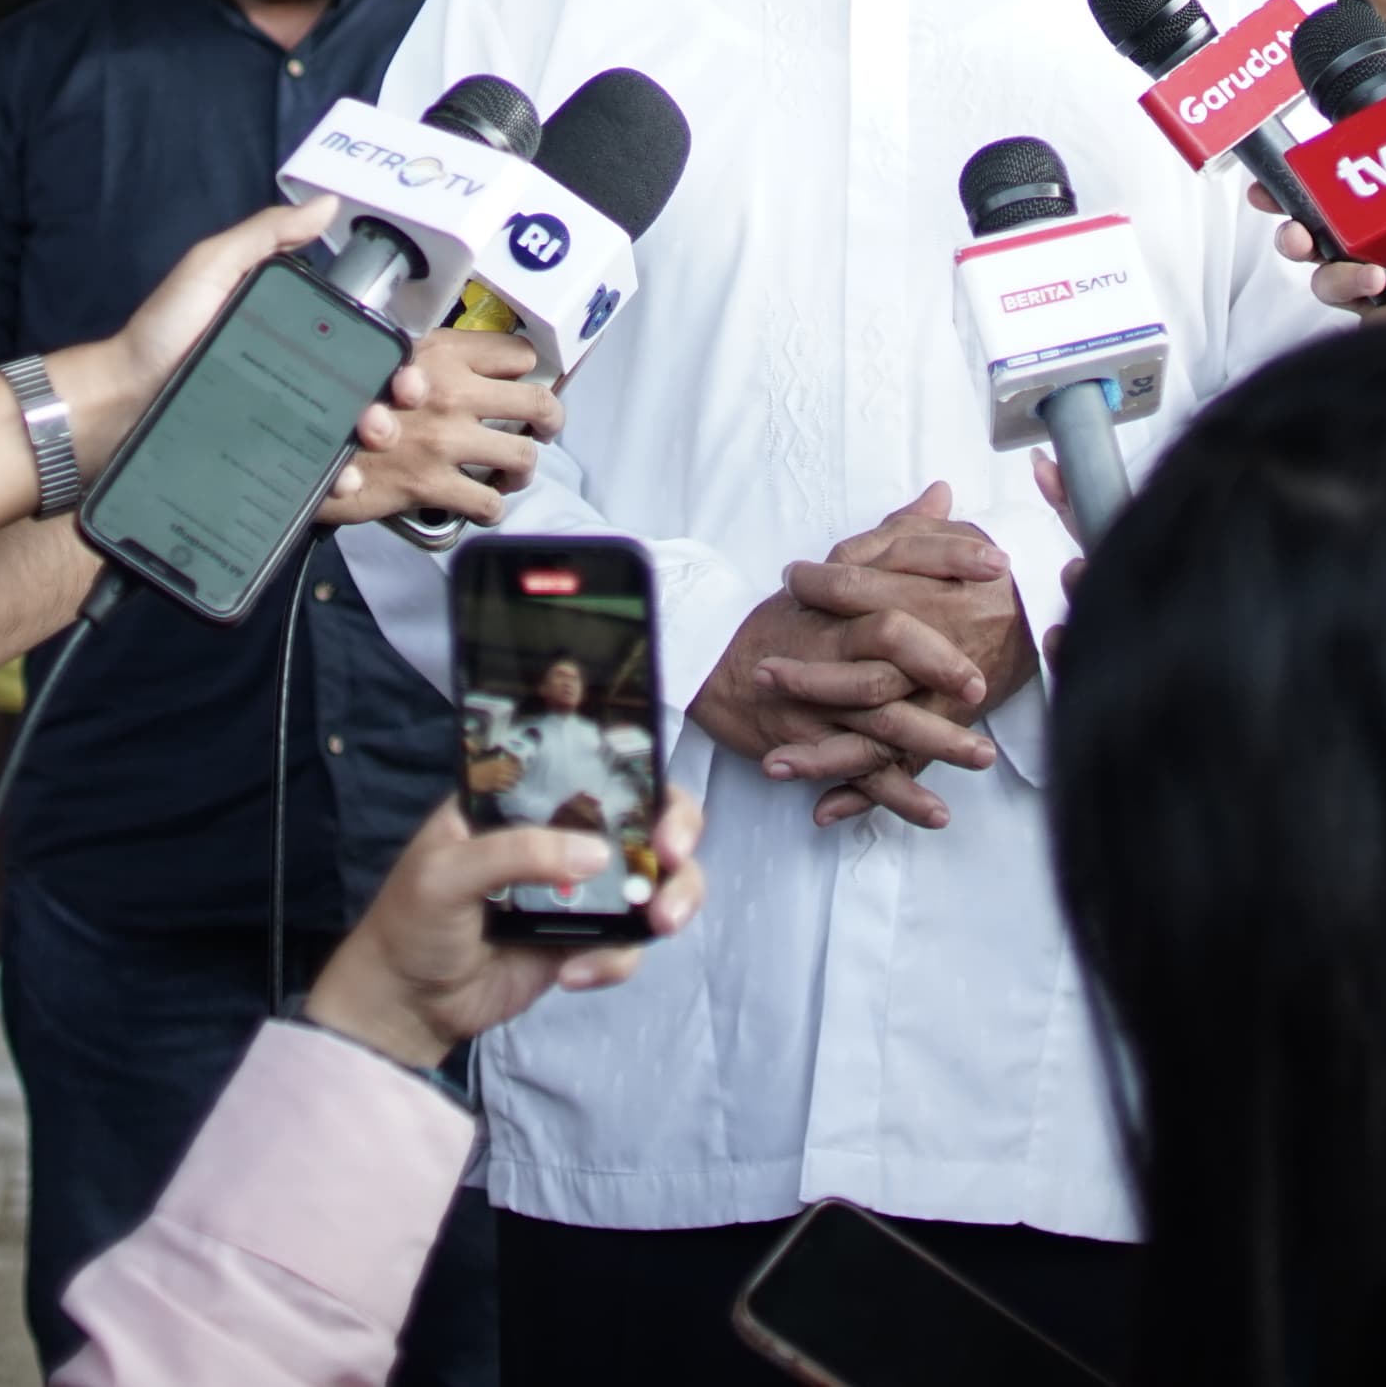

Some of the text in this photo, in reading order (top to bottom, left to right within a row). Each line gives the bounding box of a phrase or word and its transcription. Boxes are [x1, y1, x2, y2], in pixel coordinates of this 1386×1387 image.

[319, 131, 486, 197] METRO TV
[1002, 270, 1128, 311] BERITA SATU
